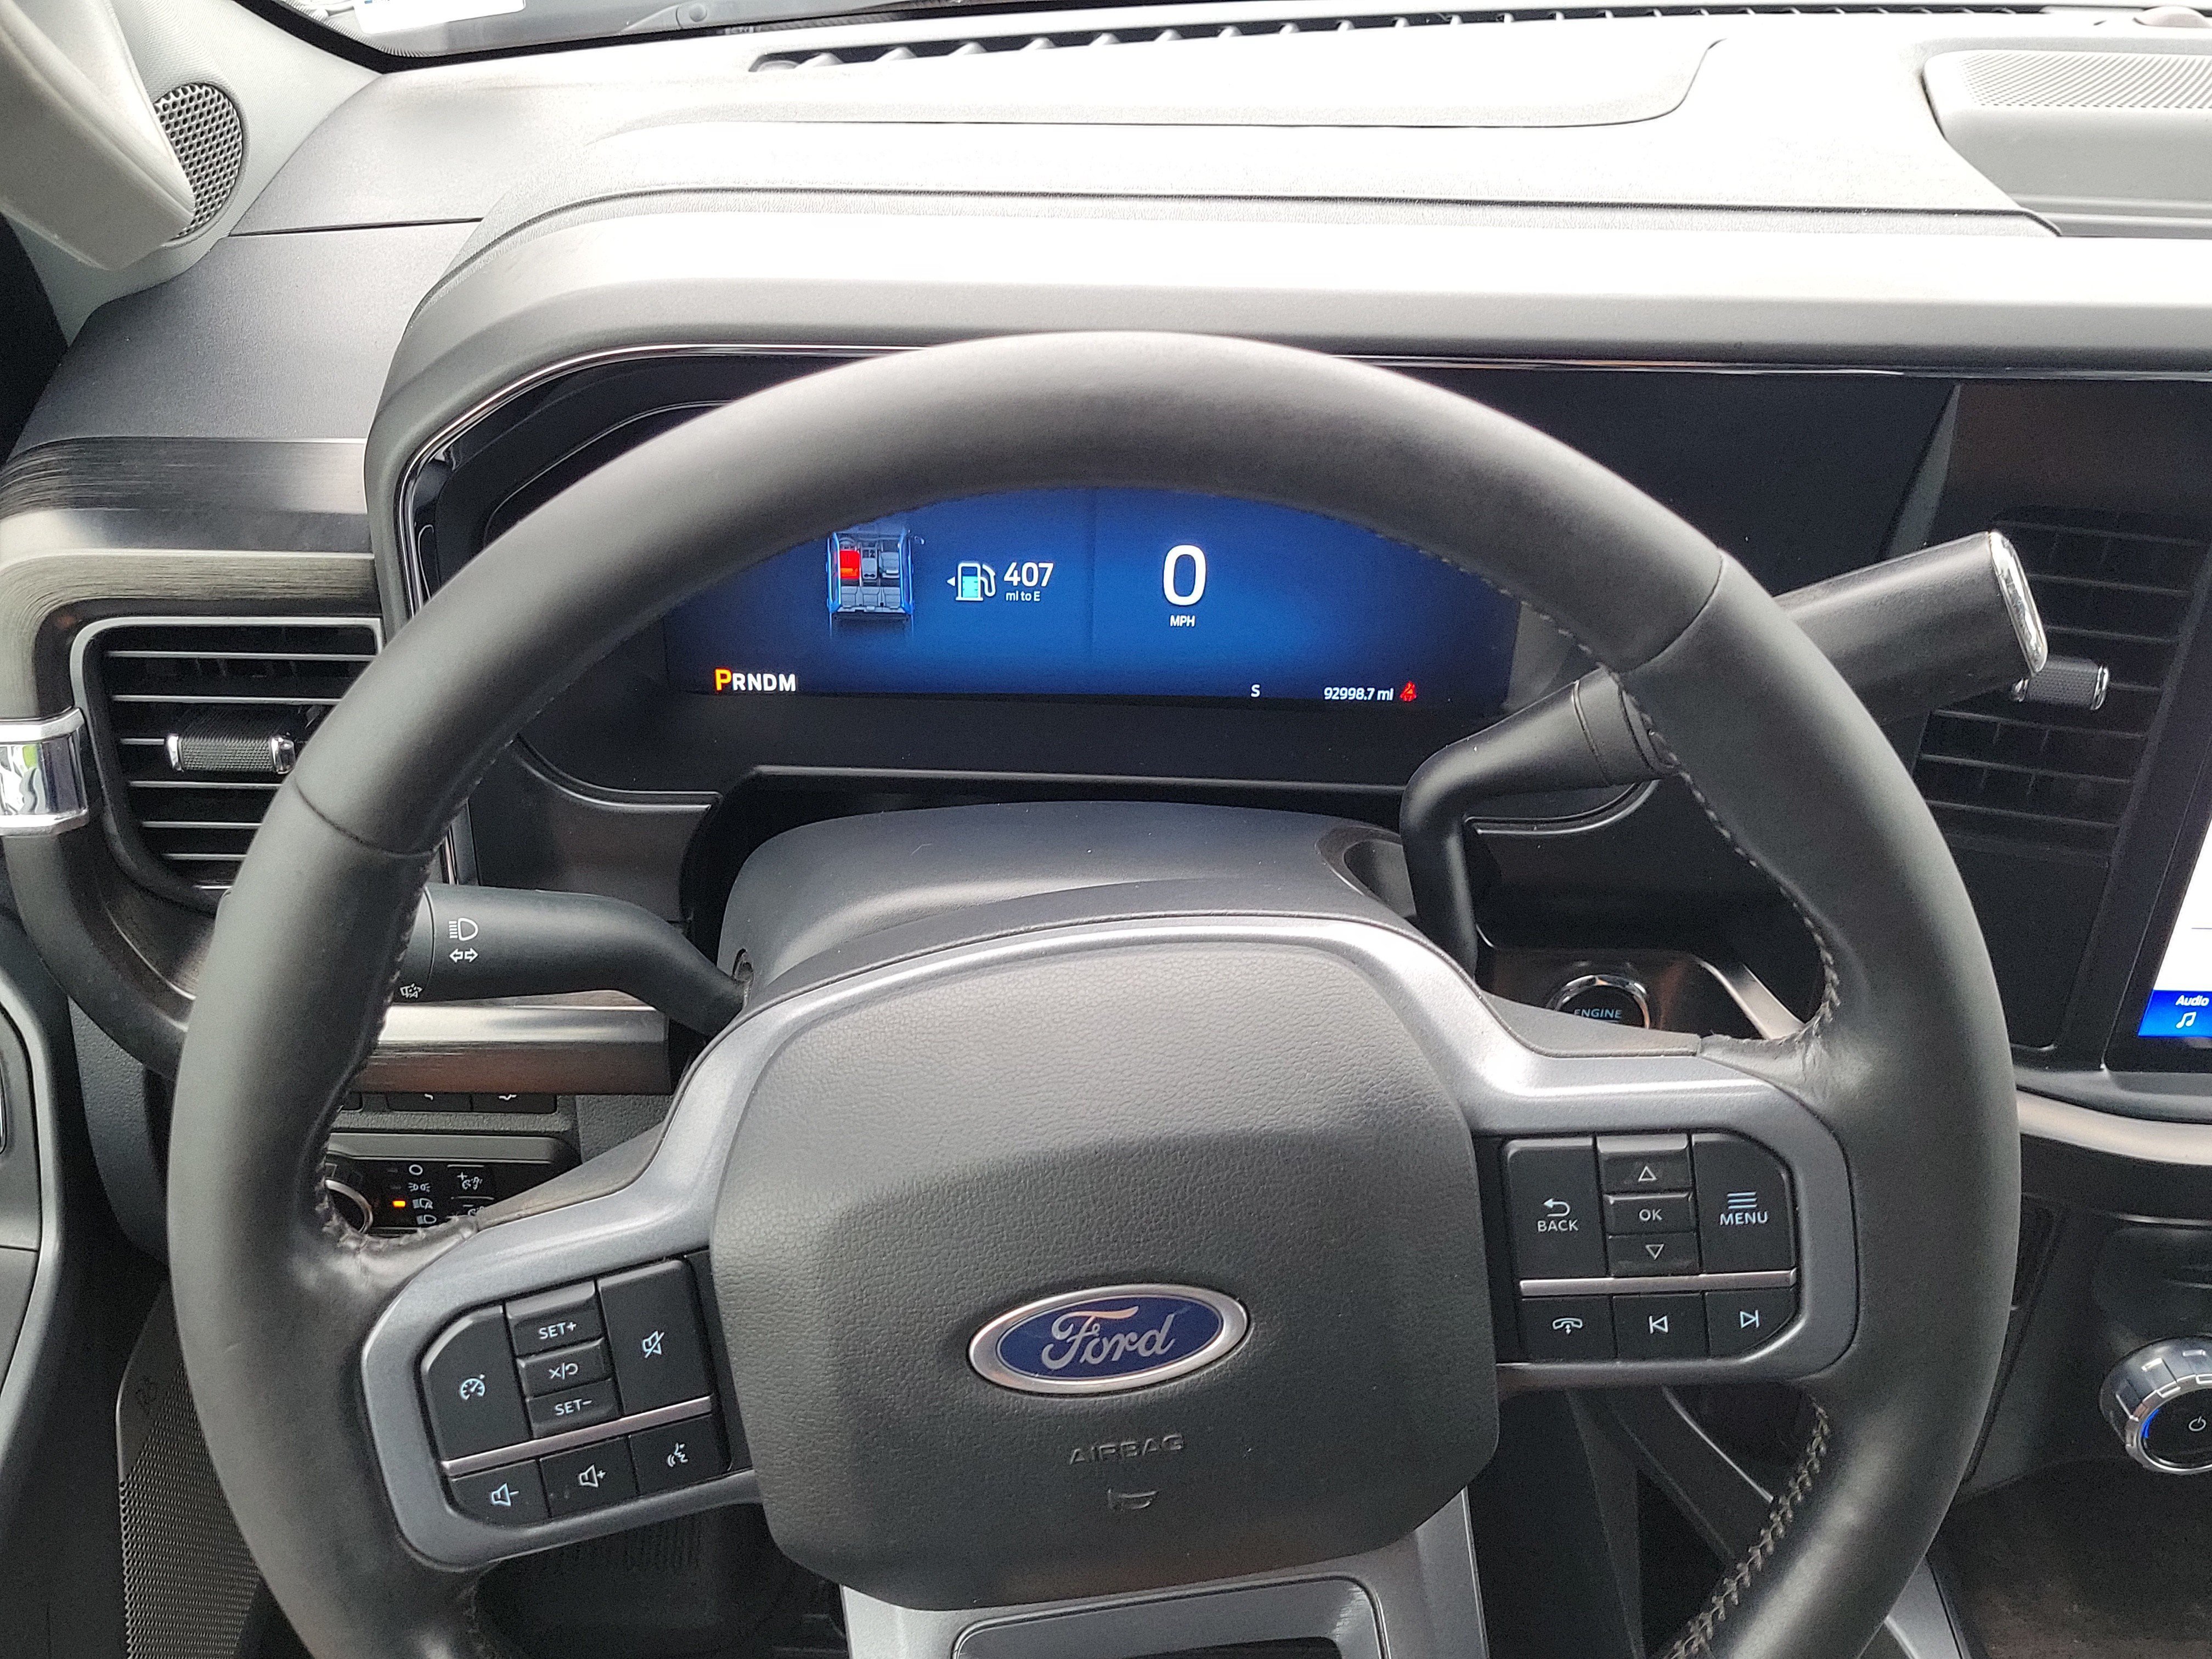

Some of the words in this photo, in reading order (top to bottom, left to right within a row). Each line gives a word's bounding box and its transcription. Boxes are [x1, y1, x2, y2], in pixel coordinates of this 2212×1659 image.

[1004, 562, 1054, 587] 407
[1163, 544, 1206, 606] 0
[1020, 591, 1032, 601] to
[1034, 591, 1041, 602] E
[1170, 615, 1195, 627] MPH
[1251, 684, 1261, 697] S
[1324, 687, 1375, 700] 92998.7
[2175, 995, 2209, 1007] Audio
[1573, 1008, 1622, 1019] ENGINE
[1639, 1208, 1662, 1221] OK
[1719, 1211, 1768, 1226] MENU
[1537, 1218, 1578, 1232] BACK
[539, 1322, 577, 1340] SET+
[1041, 1305, 1178, 1370] Ford
[1070, 1434, 1184, 1465] AIRBAG
